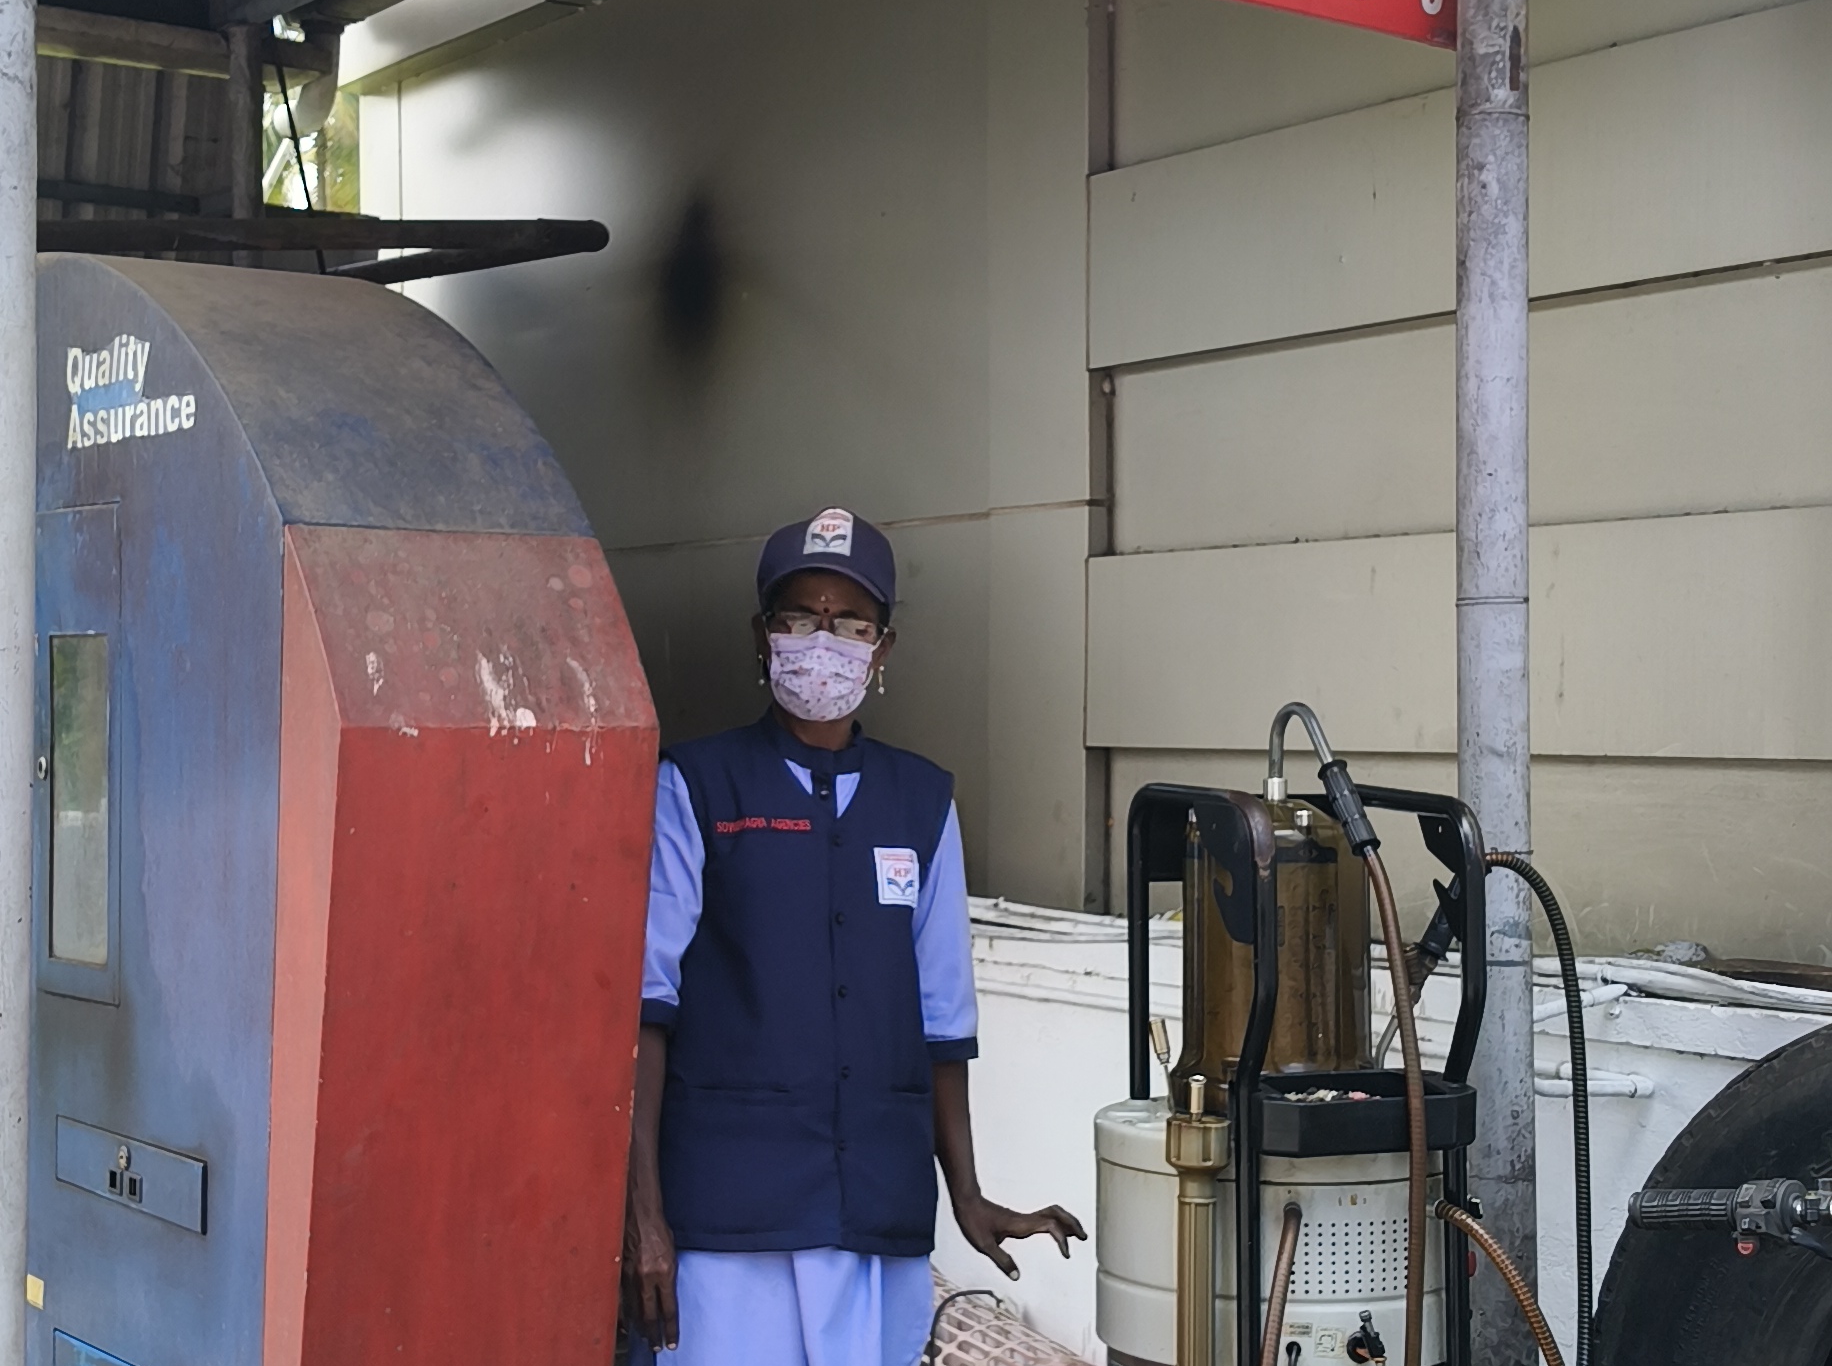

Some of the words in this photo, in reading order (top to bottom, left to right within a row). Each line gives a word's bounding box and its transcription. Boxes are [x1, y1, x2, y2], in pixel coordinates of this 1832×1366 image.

[66, 333, 151, 395] Quality
[67, 394, 197, 450] Assurance
[893, 867, 912, 878] HP
